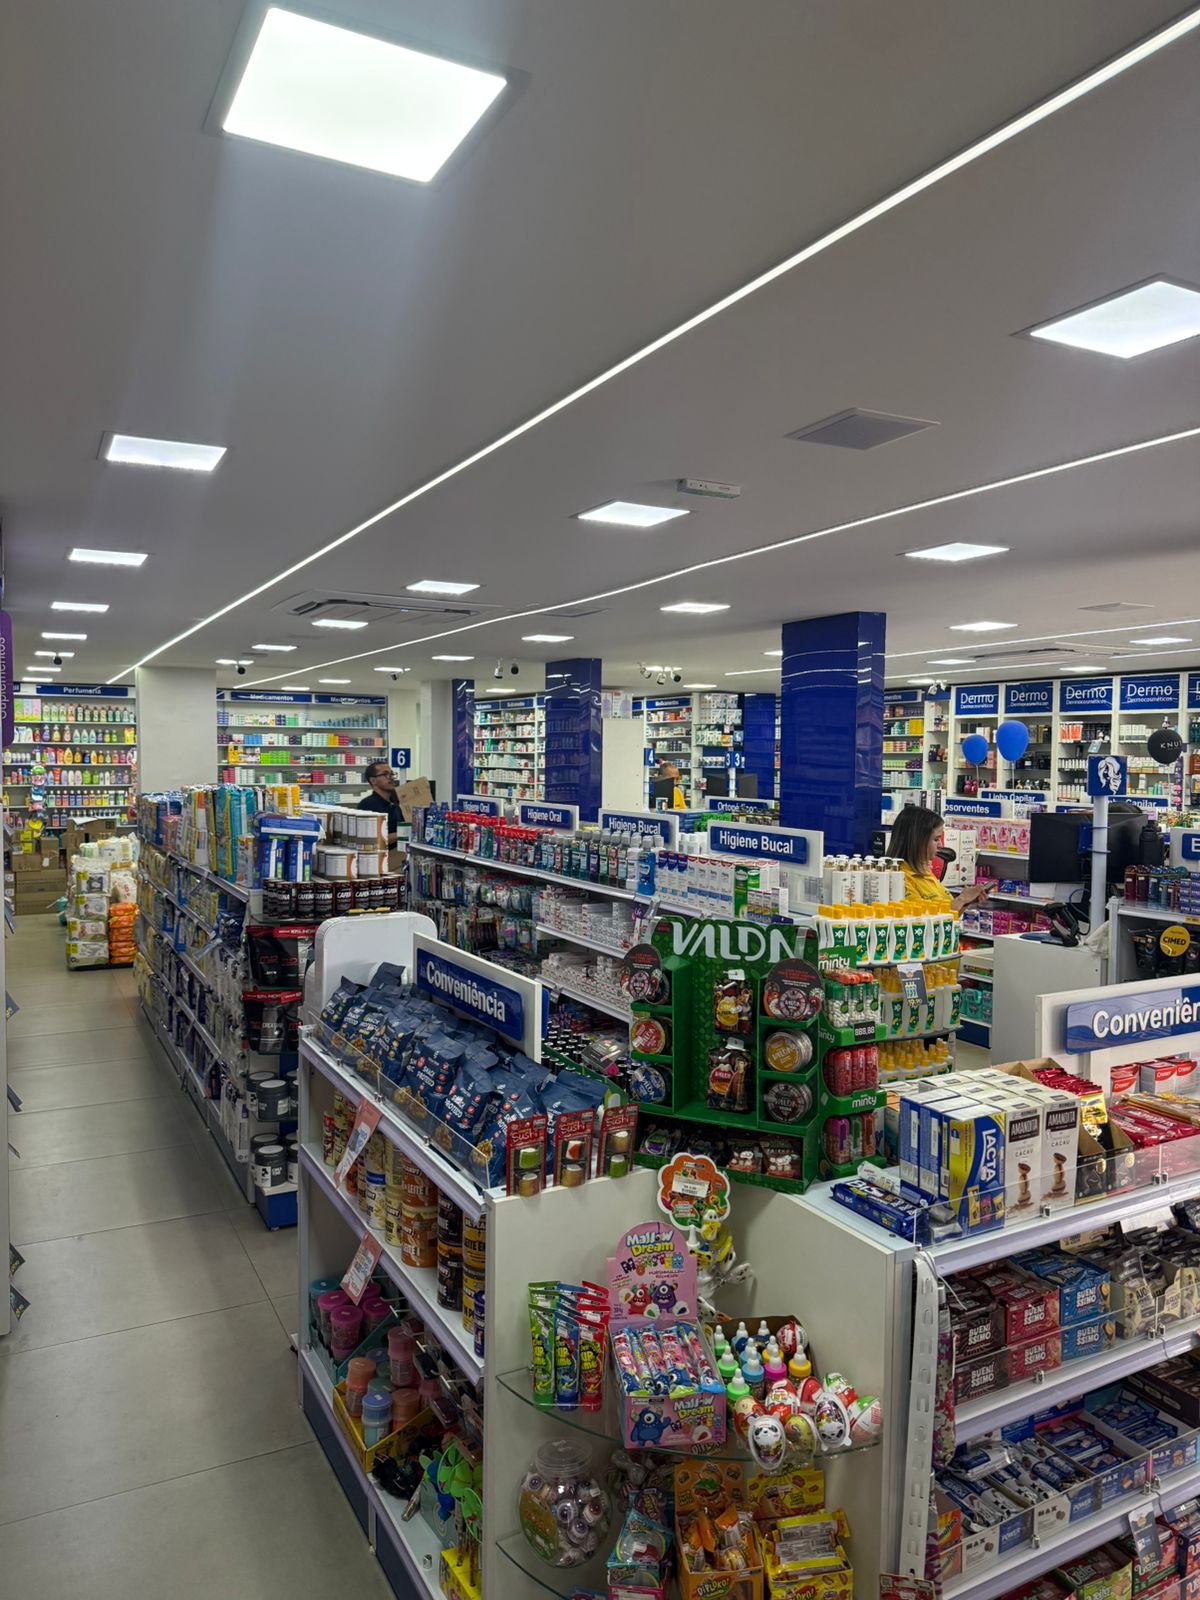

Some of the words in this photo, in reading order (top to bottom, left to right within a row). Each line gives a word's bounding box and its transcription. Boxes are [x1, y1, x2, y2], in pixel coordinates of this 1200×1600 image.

[63, 686, 101, 694] Perfumeria
[1010, 690, 1048, 702] Dermo
[1065, 686, 1107, 699] Dermo
[1126, 684, 1173, 697] Dermo
[961, 693, 994, 704] Dermo
[396, 750, 406, 767] 6
[648, 752, 655, 764] 4
[725, 753, 732, 767] 3
[735, 753, 741, 767] 3
[463, 802, 479, 813] Higiene
[479, 803, 490, 813] Oral
[527, 808, 549, 823] Higiene
[549, 811, 562, 823] Oral
[608, 817, 637, 833] Higiene
[638, 820, 661, 836] Bucal
[719, 830, 758, 850] Higiene
[761, 836, 794, 854] Bucal
[1163, 936, 1187, 946] CIMED
[818, 956, 850, 971] minty
[426, 960, 506, 1024] Conveniência
[852, 1095, 877, 1108] minty
[510, 1128, 538, 1142] Sushi
[1051, 1139, 1070, 1147] CACAU
[980, 1128, 997, 1182] LACTA
[1015, 1148, 1034, 1157] CACAU
[626, 1230, 674, 1247] Mallow
[631, 1243, 675, 1257] Dream
[1037, 1505, 1057, 1517] MAX
[966, 1538, 985, 1550] MAX
